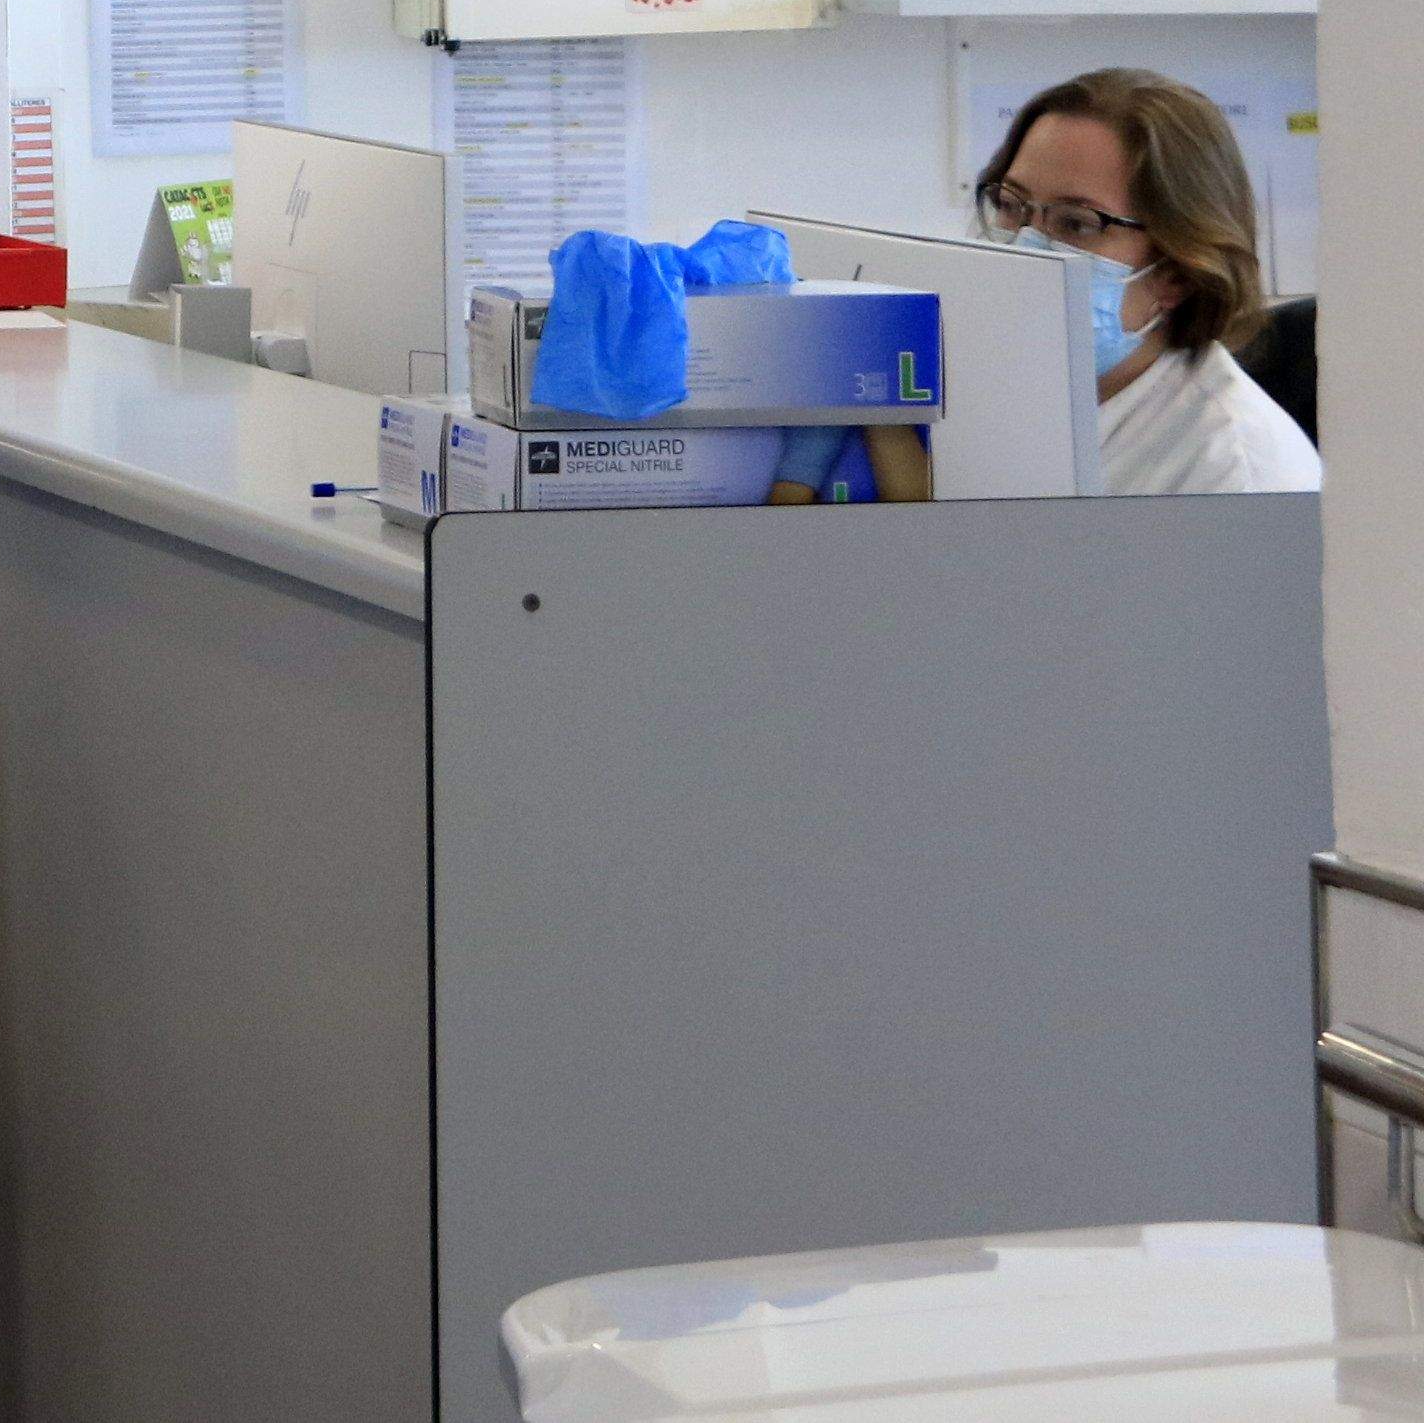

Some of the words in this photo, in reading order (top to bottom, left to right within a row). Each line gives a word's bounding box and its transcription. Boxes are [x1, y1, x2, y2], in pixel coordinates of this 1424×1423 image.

[899, 350, 932, 402] L
[566, 438, 685, 457] MEDIGUARD
[565, 459, 627, 474] SPECIAL
[630, 458, 684, 472] NITRILE
